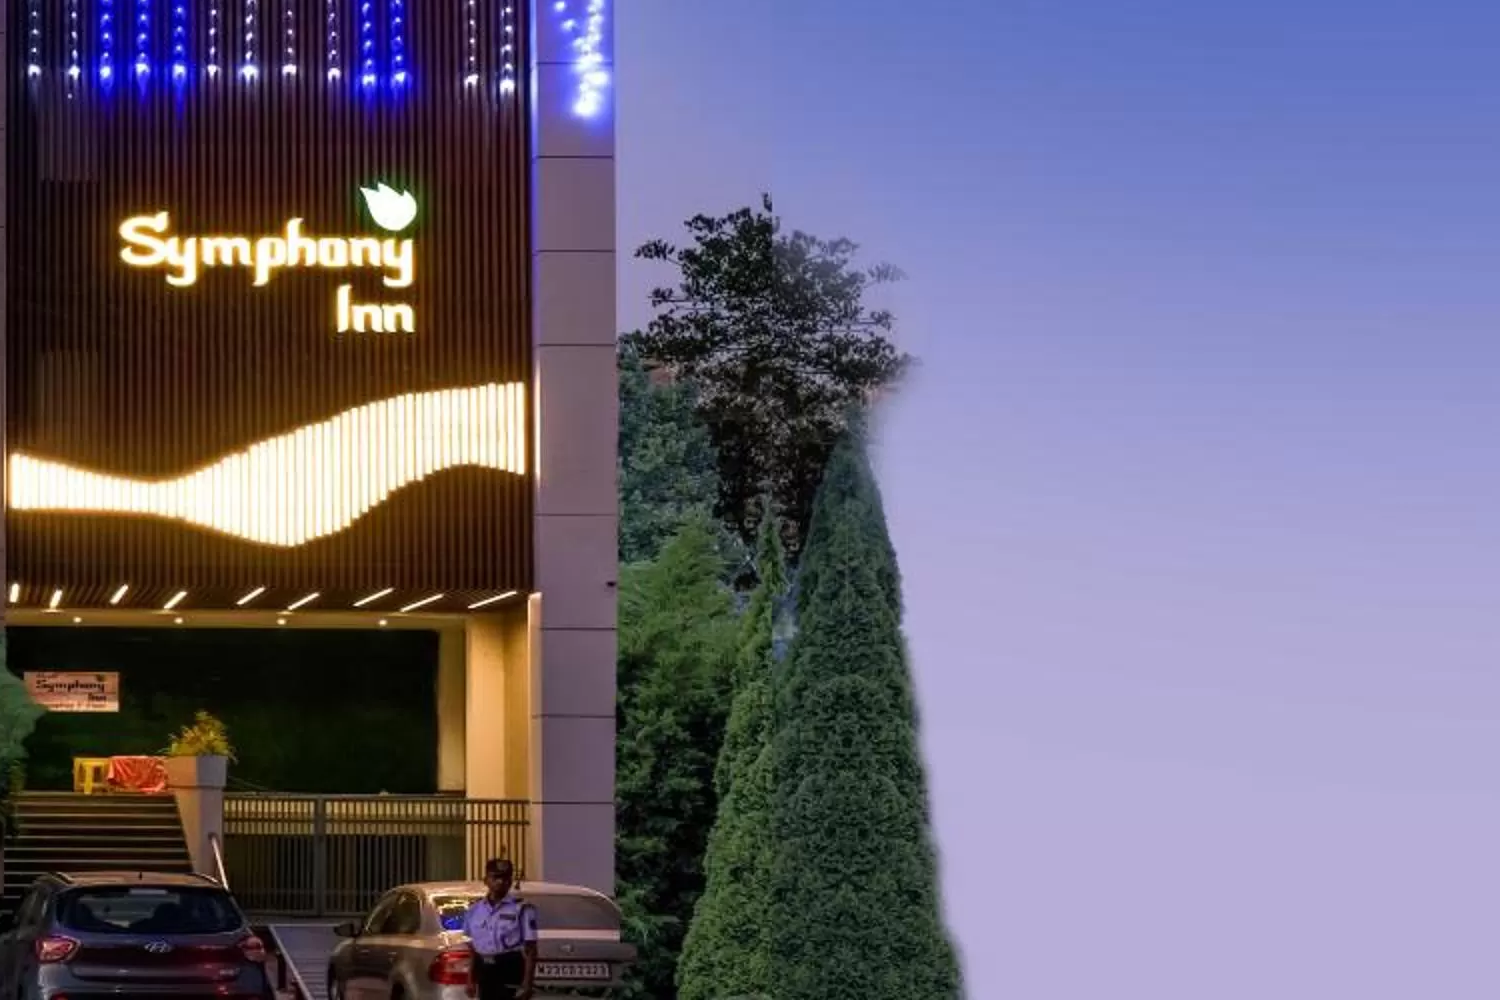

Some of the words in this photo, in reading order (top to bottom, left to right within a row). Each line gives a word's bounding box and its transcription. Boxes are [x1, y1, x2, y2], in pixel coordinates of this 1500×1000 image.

[118, 210, 414, 288] Symphony
[336, 284, 416, 334] Inn
[35, 679, 105, 692] Symphony
